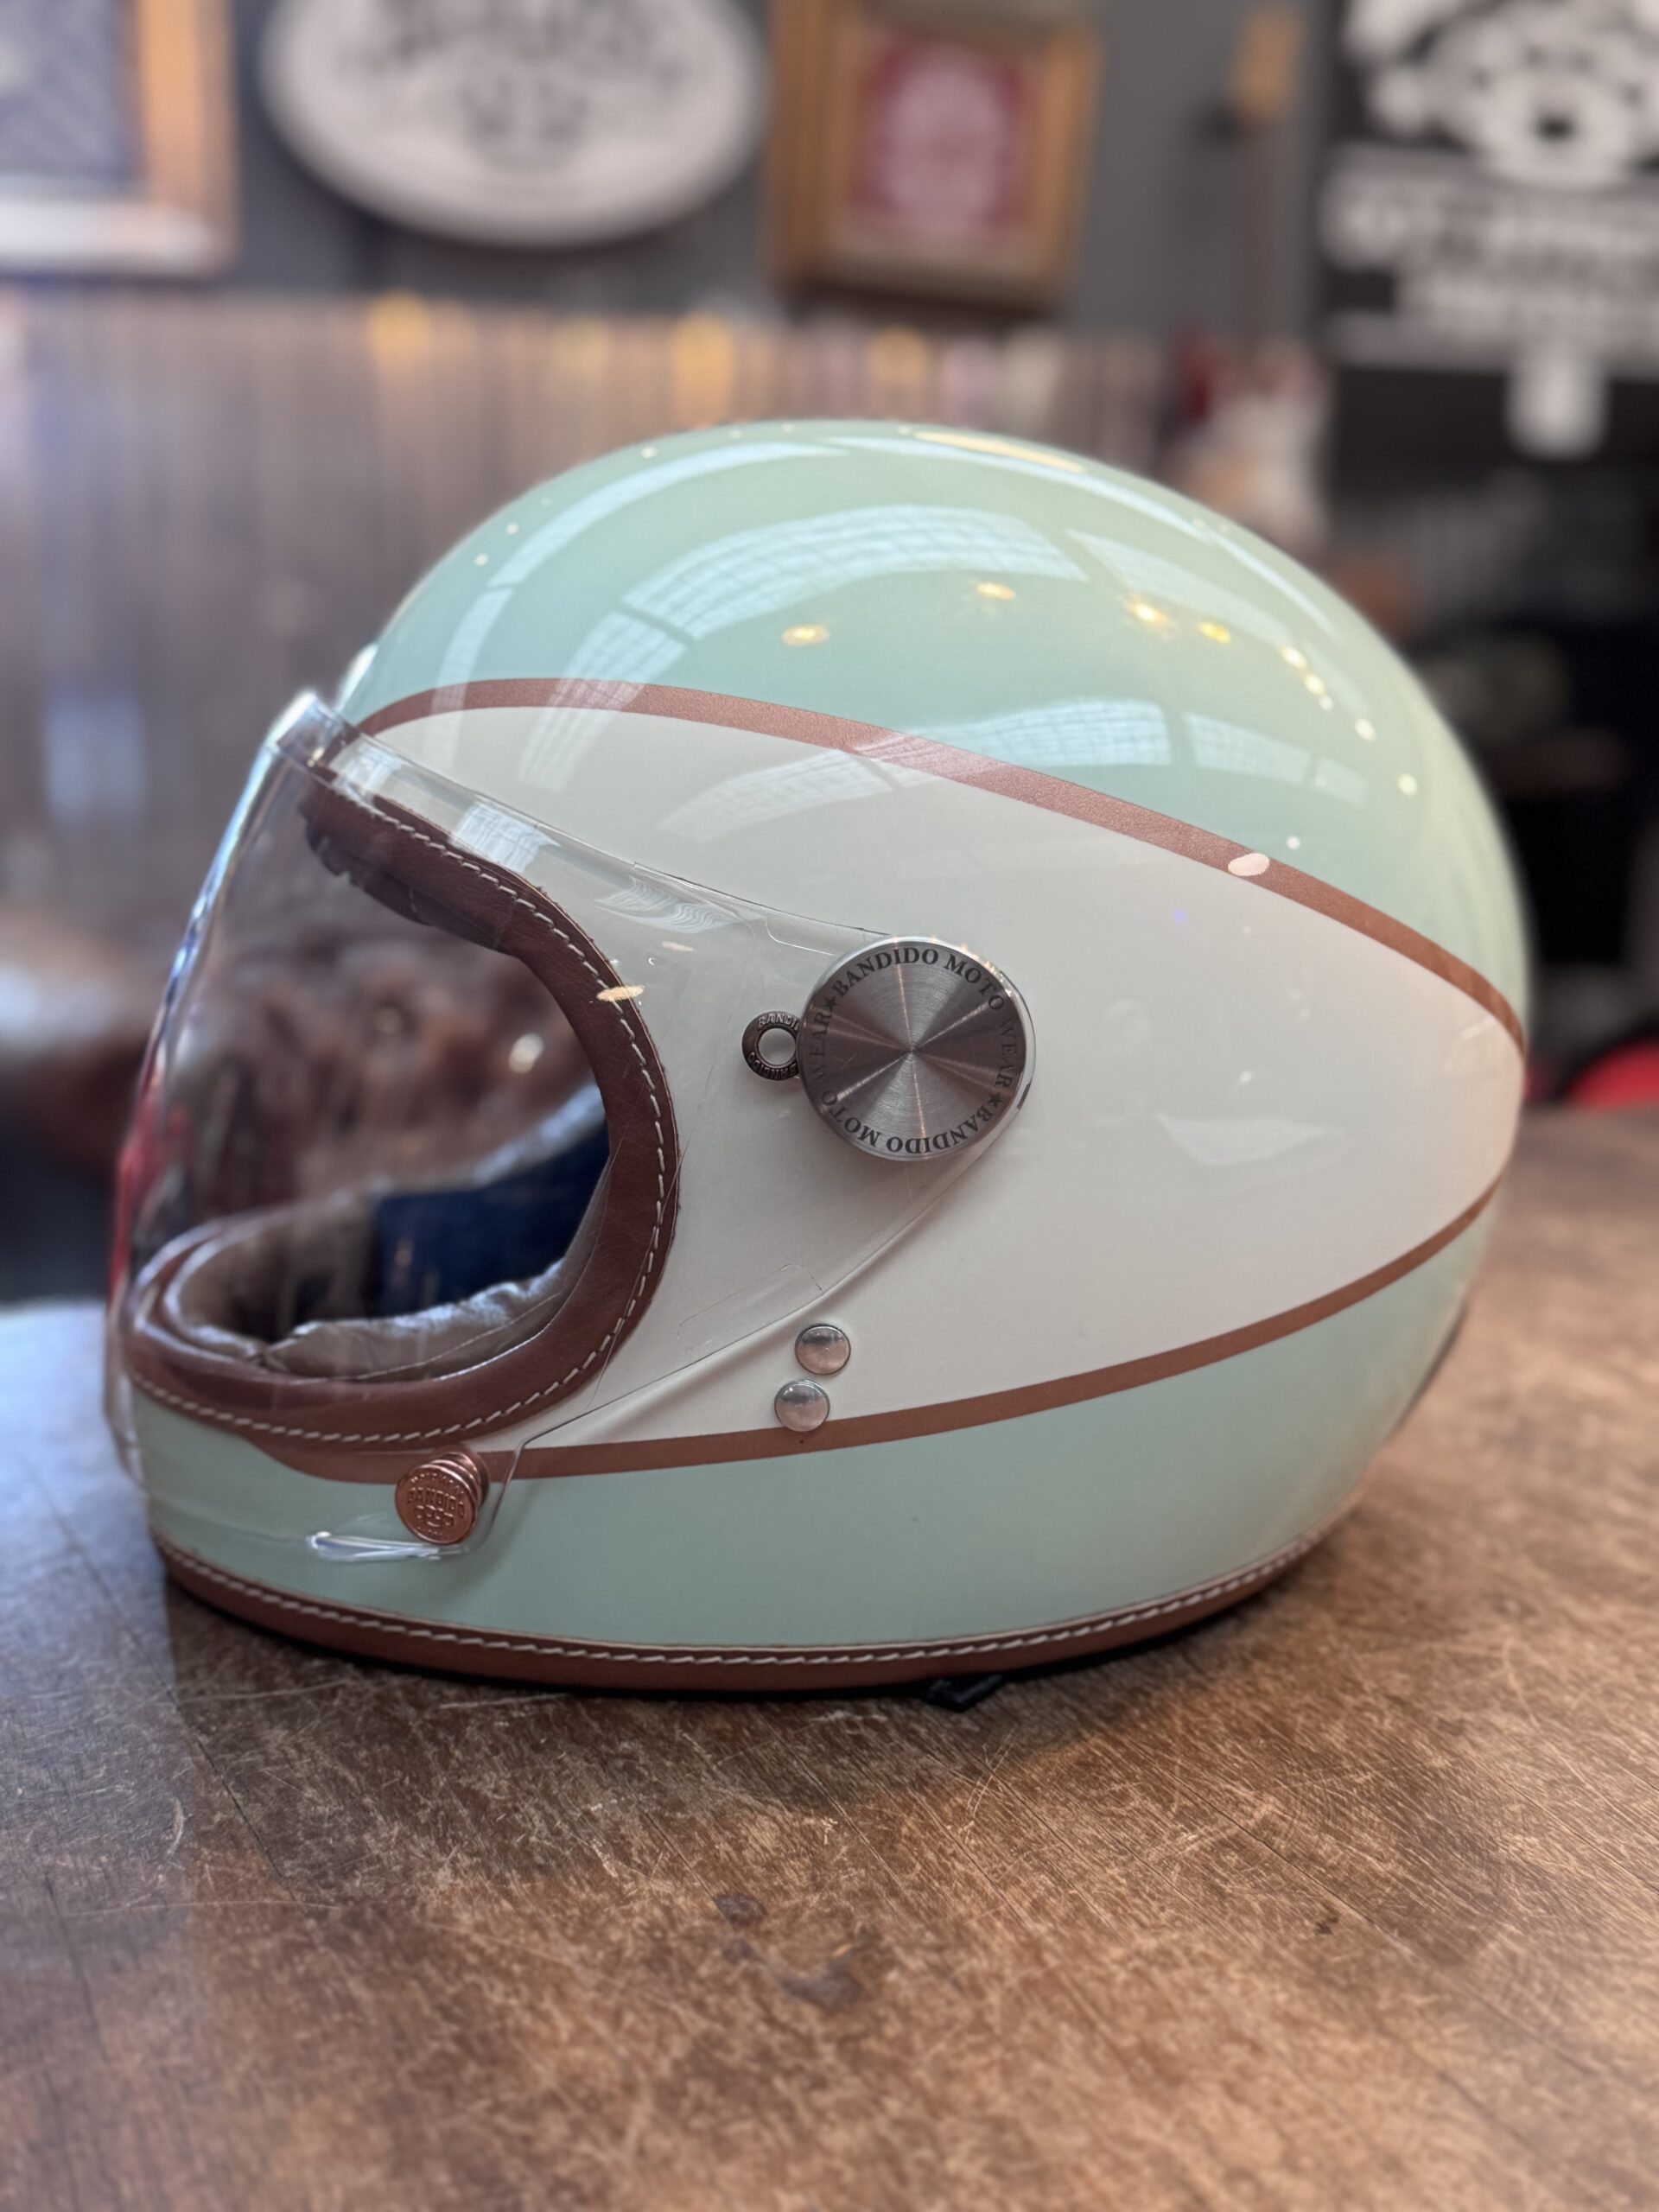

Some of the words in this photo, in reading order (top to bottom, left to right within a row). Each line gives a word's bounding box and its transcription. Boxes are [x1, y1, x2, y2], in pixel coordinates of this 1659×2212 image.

[809, 1009, 831, 1081] WEAR
[832, 946, 939, 997] BANDIDO
[944, 951, 1005, 1011] MOTO
[995, 1017, 1019, 1089] WEAR
[822, 1090, 880, 1147] MOTO
[886, 1106, 995, 1154] BANDIDO
